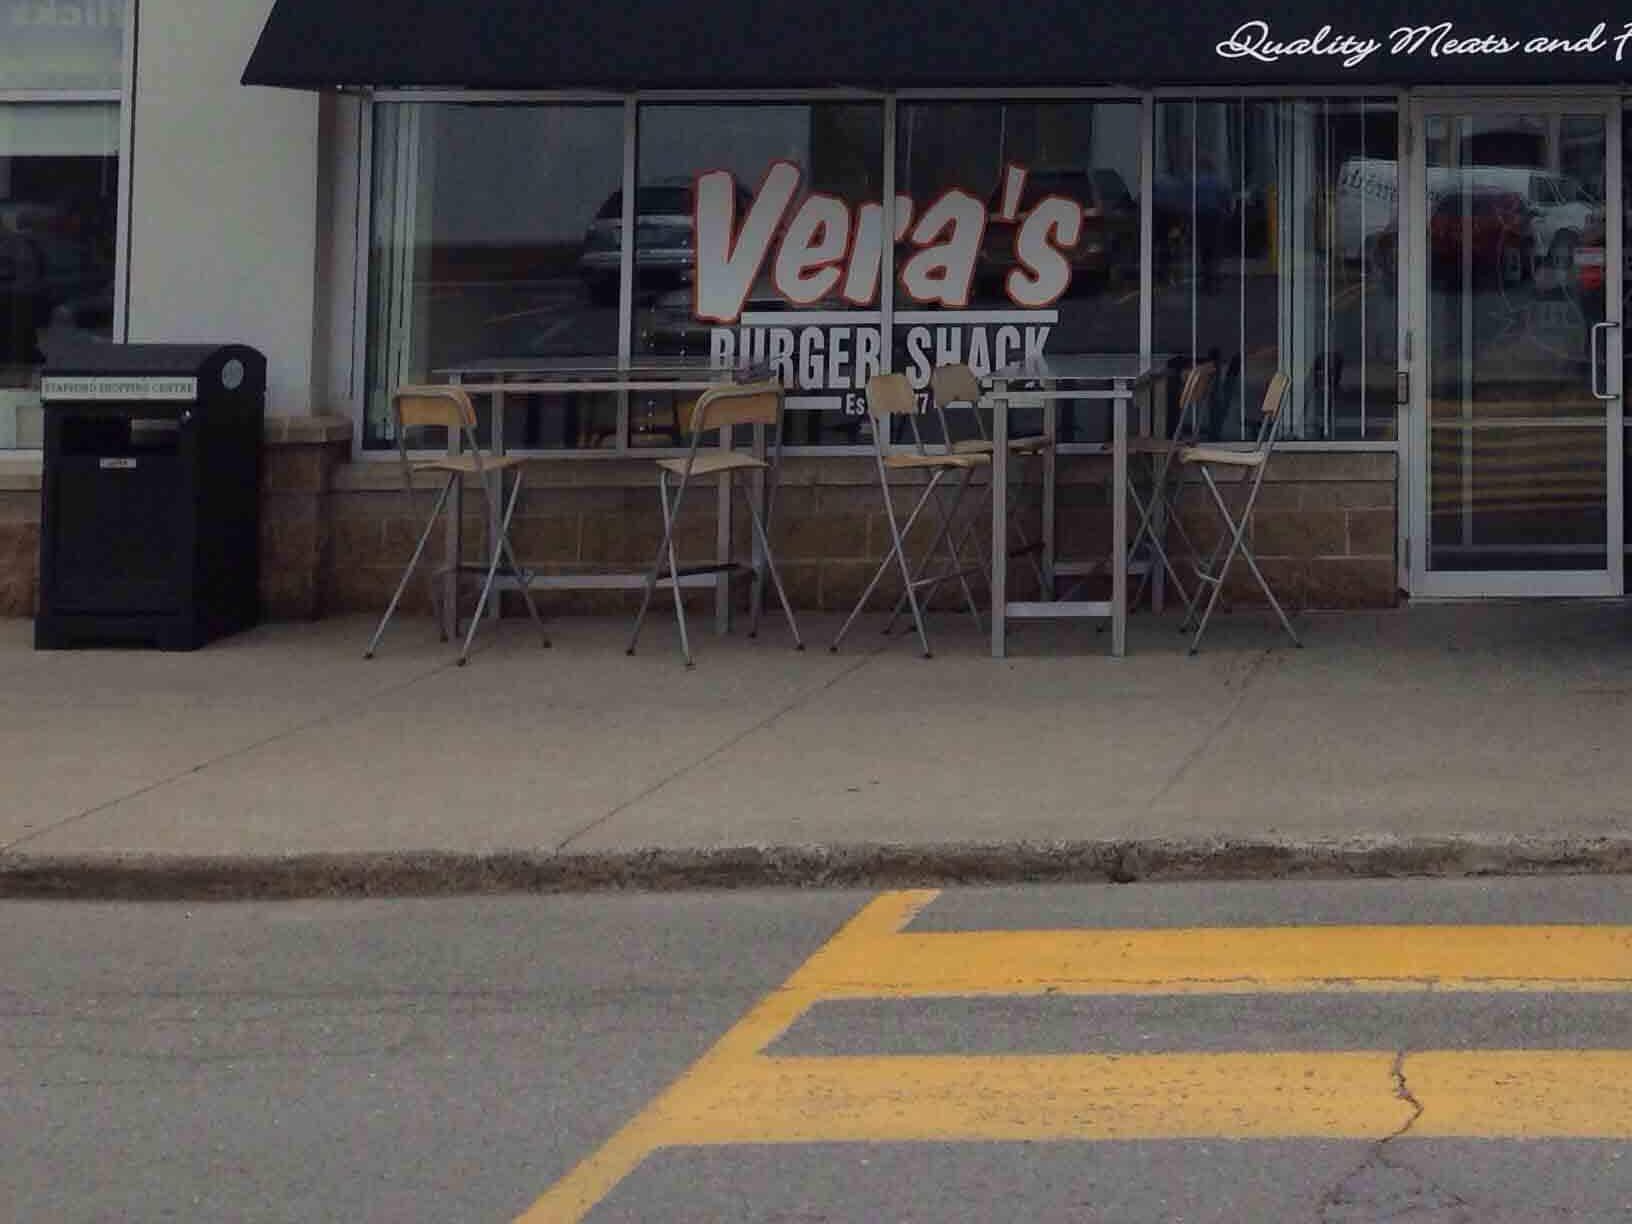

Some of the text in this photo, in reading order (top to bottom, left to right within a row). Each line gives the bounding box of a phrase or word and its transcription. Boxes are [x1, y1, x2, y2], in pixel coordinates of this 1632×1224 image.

[1215, 20, 1381, 67] Quality
[1389, 22, 1519, 58] Meats
[1524, 22, 1607, 53] and
[693, 159, 1082, 323] Vera's
